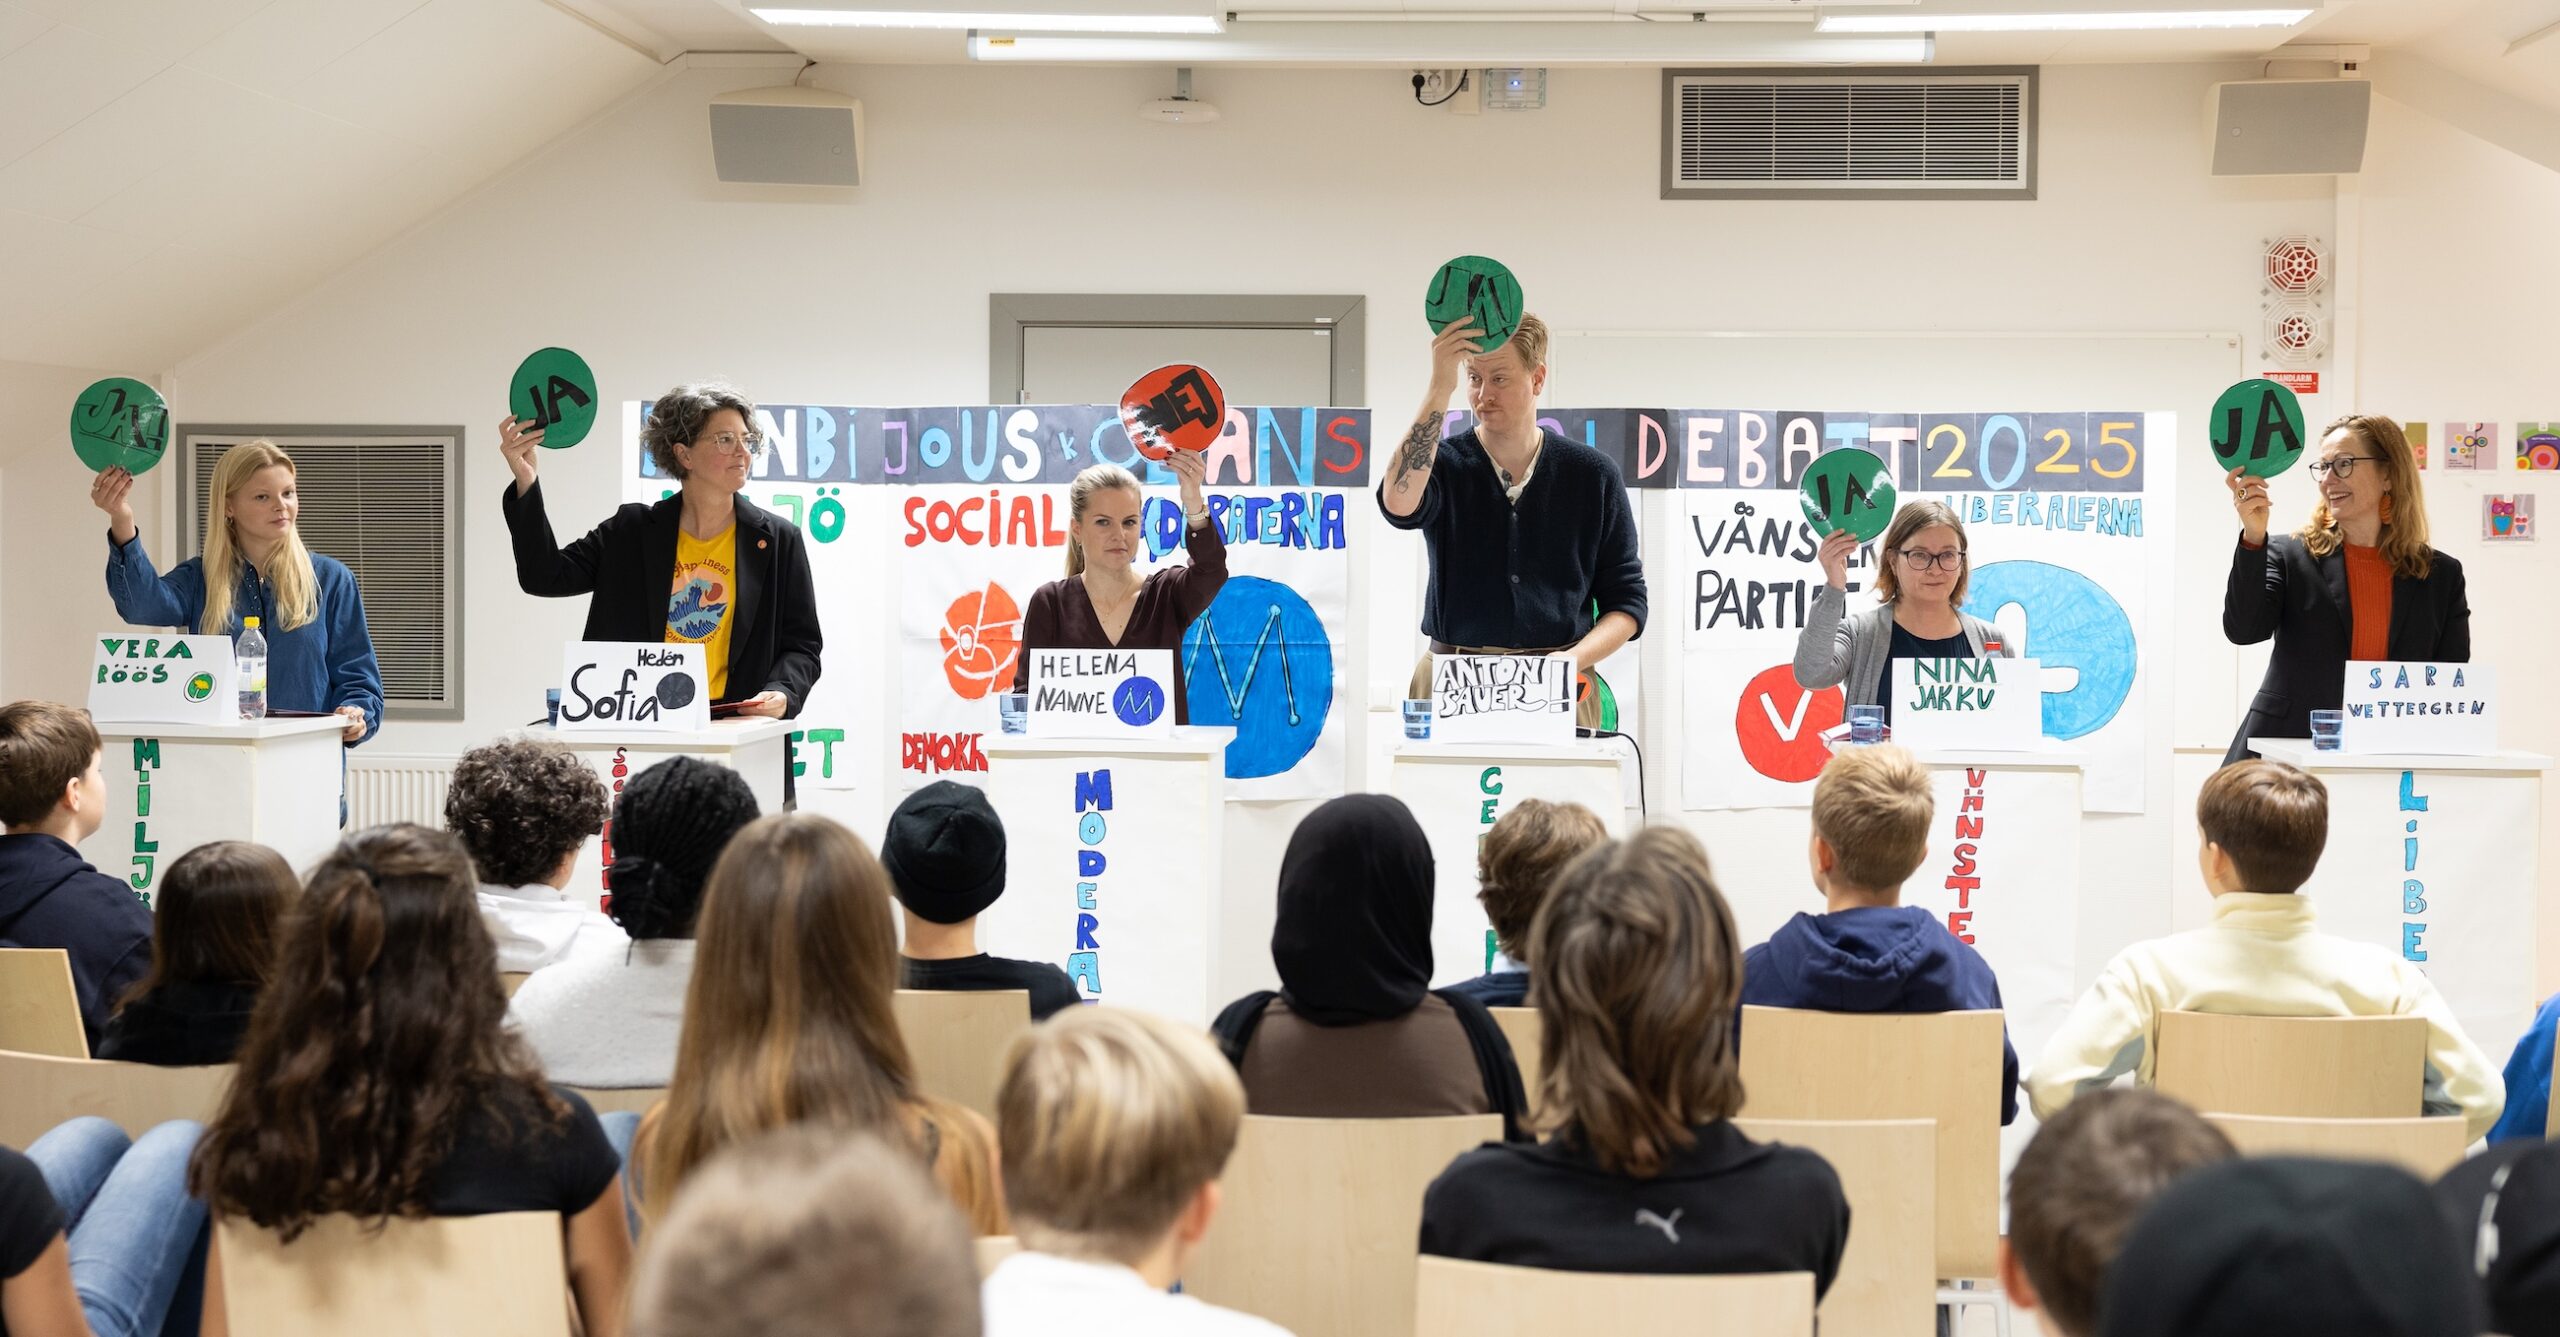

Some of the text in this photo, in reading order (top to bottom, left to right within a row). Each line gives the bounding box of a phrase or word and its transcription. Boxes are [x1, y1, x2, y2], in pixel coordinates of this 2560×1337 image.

[520, 374, 592, 435] JA
[1134, 367, 1220, 446] NEJ
[2212, 389, 2301, 461] JA
[1926, 414, 2138, 491] 2025
[1811, 472, 1878, 523] JA
[101, 638, 193, 659] VERA
[637, 648, 685, 667] Hedén
[97, 663, 169, 684] RÖÖS
[1040, 653, 1137, 679] HELENA
[1433, 656, 1547, 693] ANTON
[1914, 658, 1997, 686] NINA
[2369, 665, 2465, 689] SARA
[561, 663, 659, 722] Sofia
[1034, 684, 1108, 715] NANNE
[1910, 685, 1995, 711] JAKKU
[2347, 700, 2485, 719] WETTERGREN
[1759, 690, 1813, 742] V
[1067, 769, 1113, 1005] MODERA
